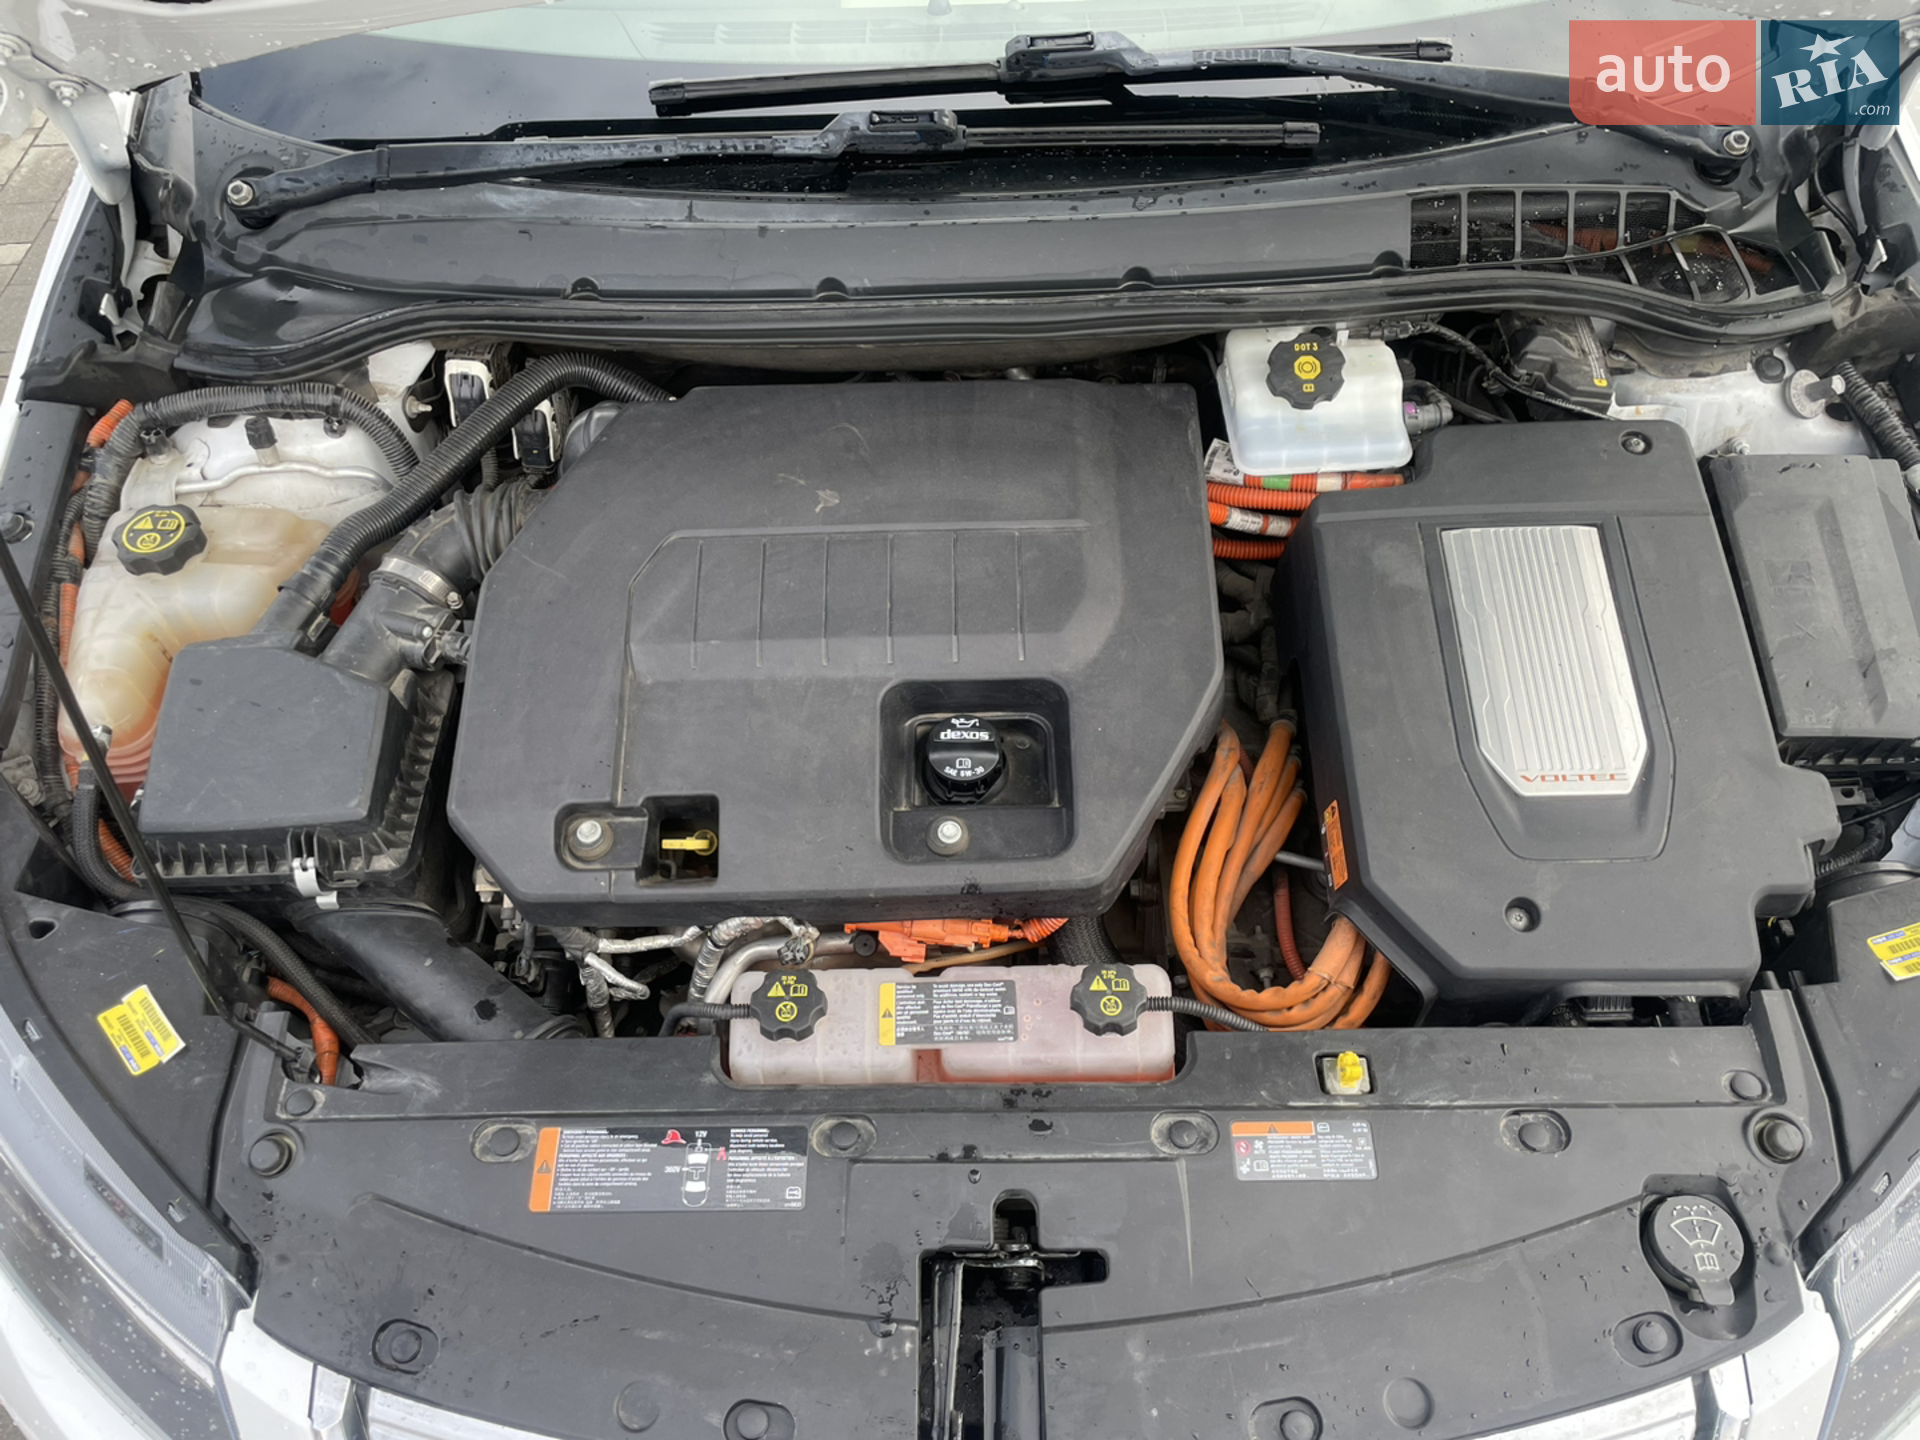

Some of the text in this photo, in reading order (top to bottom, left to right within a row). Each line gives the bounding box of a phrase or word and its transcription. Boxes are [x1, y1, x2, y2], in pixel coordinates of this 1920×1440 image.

[1294, 342, 1319, 352] DOT 3
[940, 729, 990, 740] dexos
[944, 766, 985, 777] SAE 5W-30
[1520, 773, 1628, 783] VOLTEC
